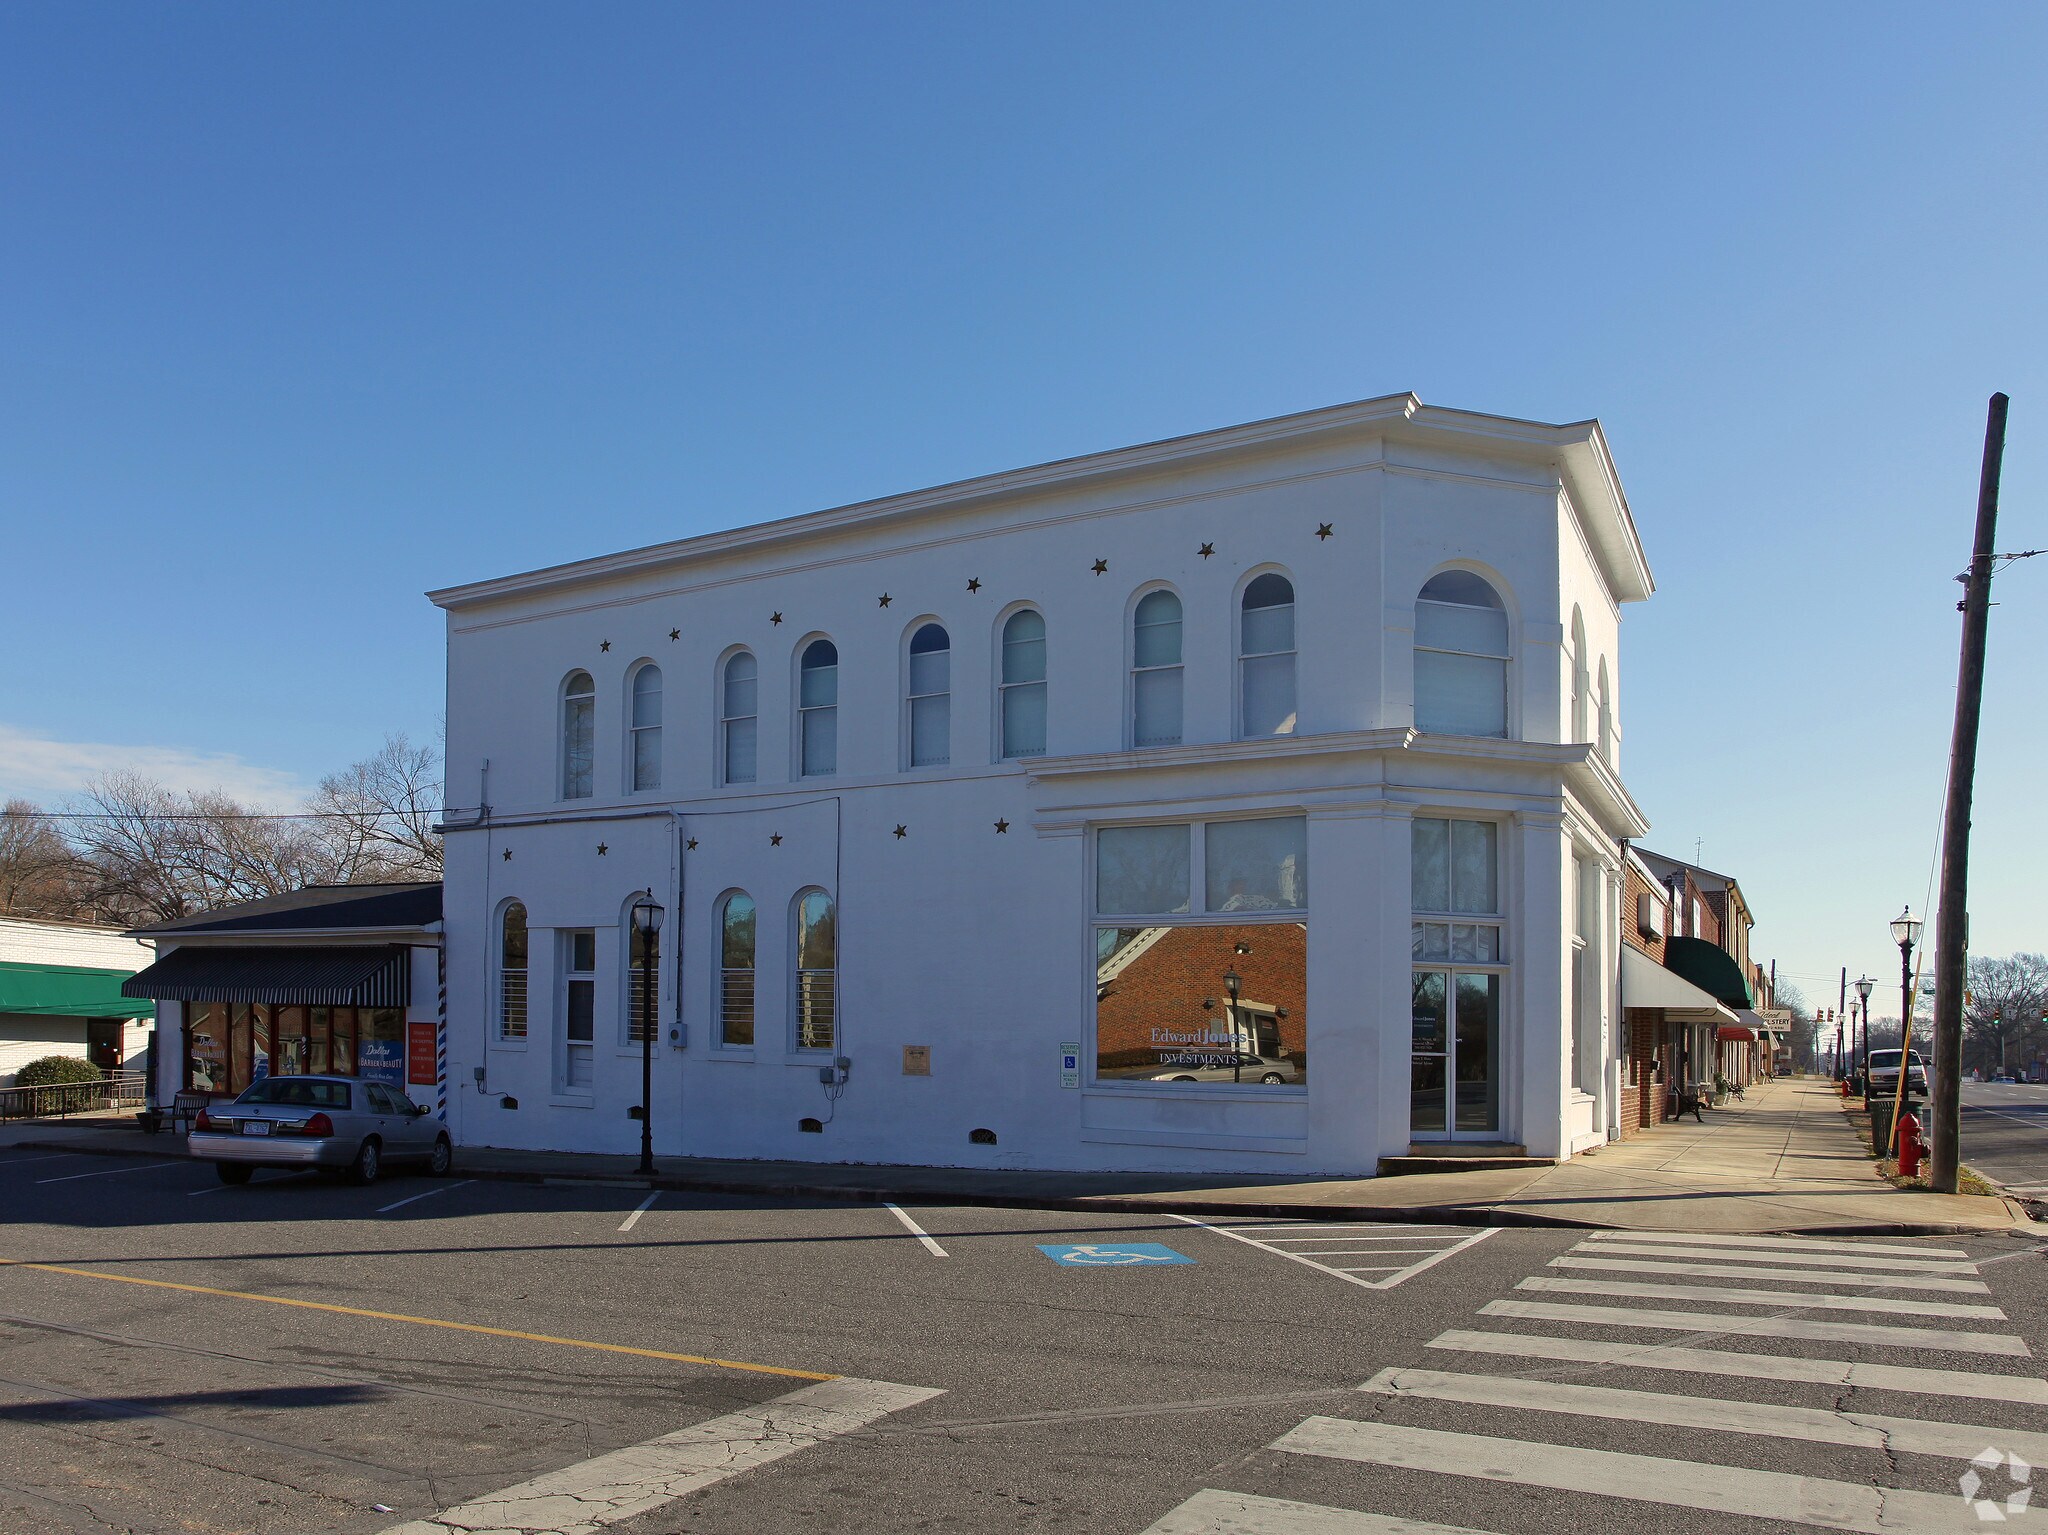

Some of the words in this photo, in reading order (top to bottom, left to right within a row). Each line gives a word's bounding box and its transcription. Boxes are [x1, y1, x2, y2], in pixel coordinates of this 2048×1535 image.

[365, 1044, 390, 1055] Dallas
[360, 1057, 380, 1067] BARBER
[383, 1058, 402, 1068] BEAUTY
[1160, 1053, 1238, 1065] INVESTMENTS
